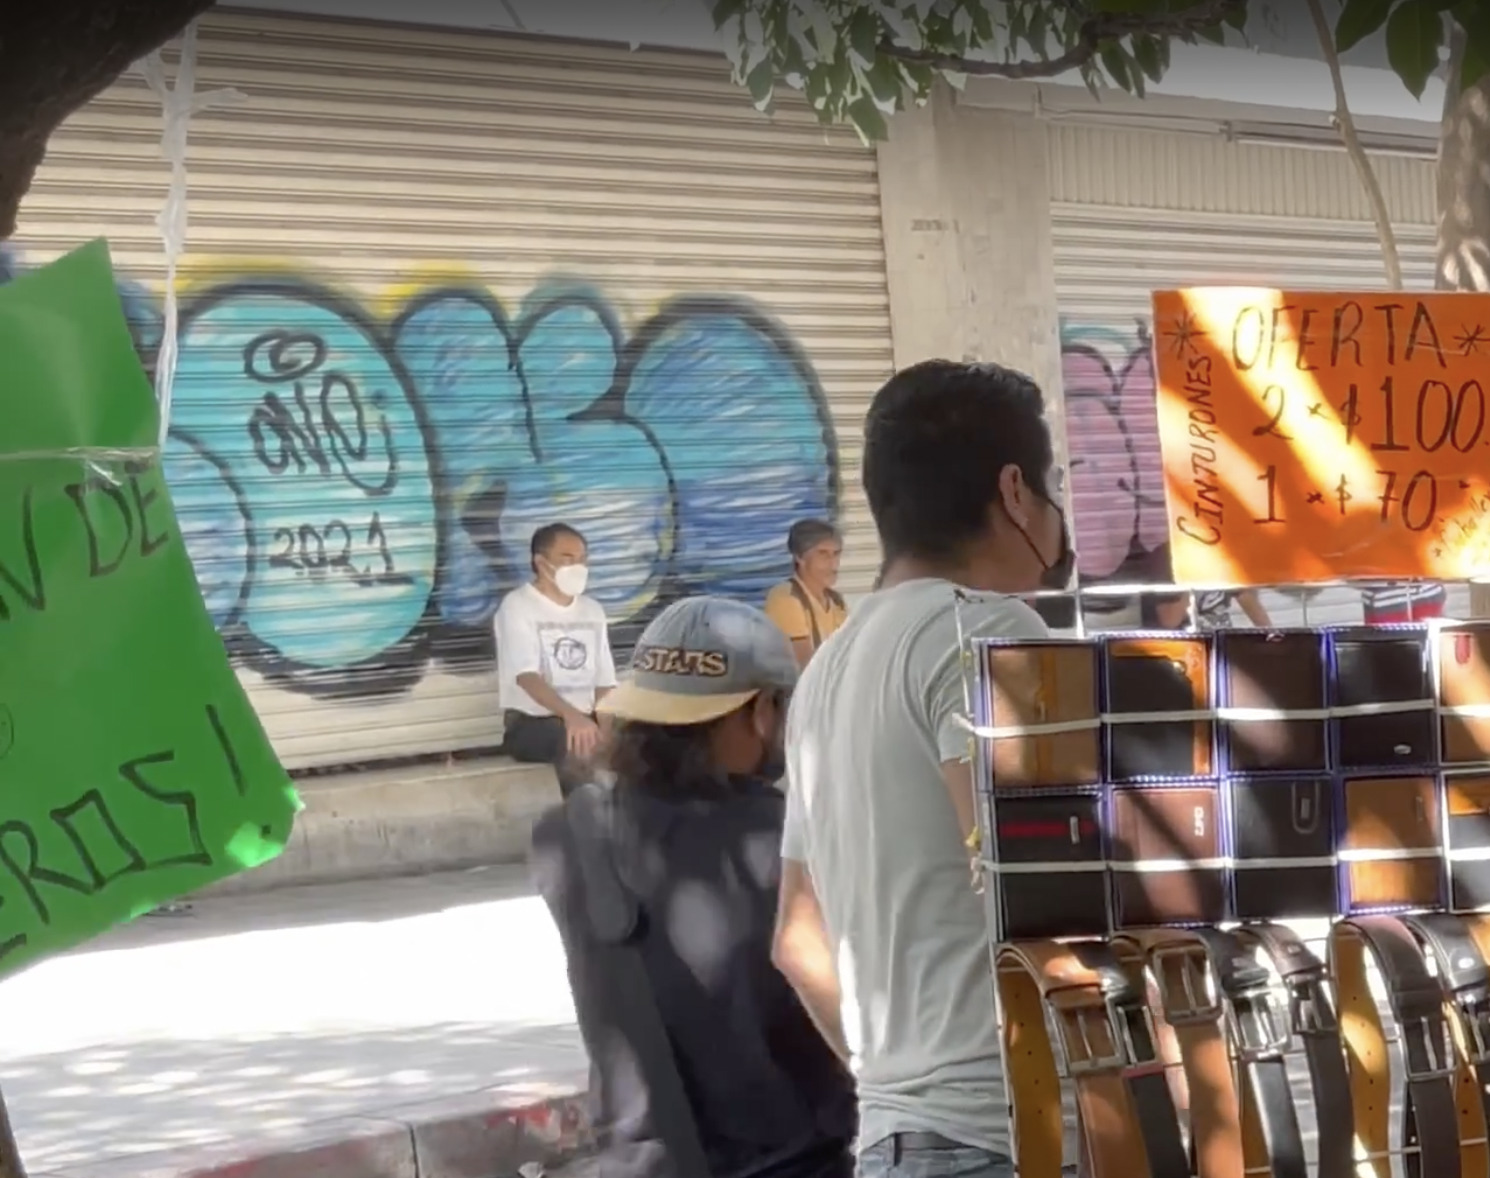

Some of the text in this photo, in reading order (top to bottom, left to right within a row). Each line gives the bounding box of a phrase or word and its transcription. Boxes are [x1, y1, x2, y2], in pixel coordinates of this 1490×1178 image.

[1232, 301, 1447, 371] OFERTA
[1252, 384, 1295, 440] 2
[1176, 355, 1224, 545] CINTURONES
[64, 460, 169, 577] DE
[1253, 465, 1286, 524] 1
[269, 511, 414, 585] 2021
